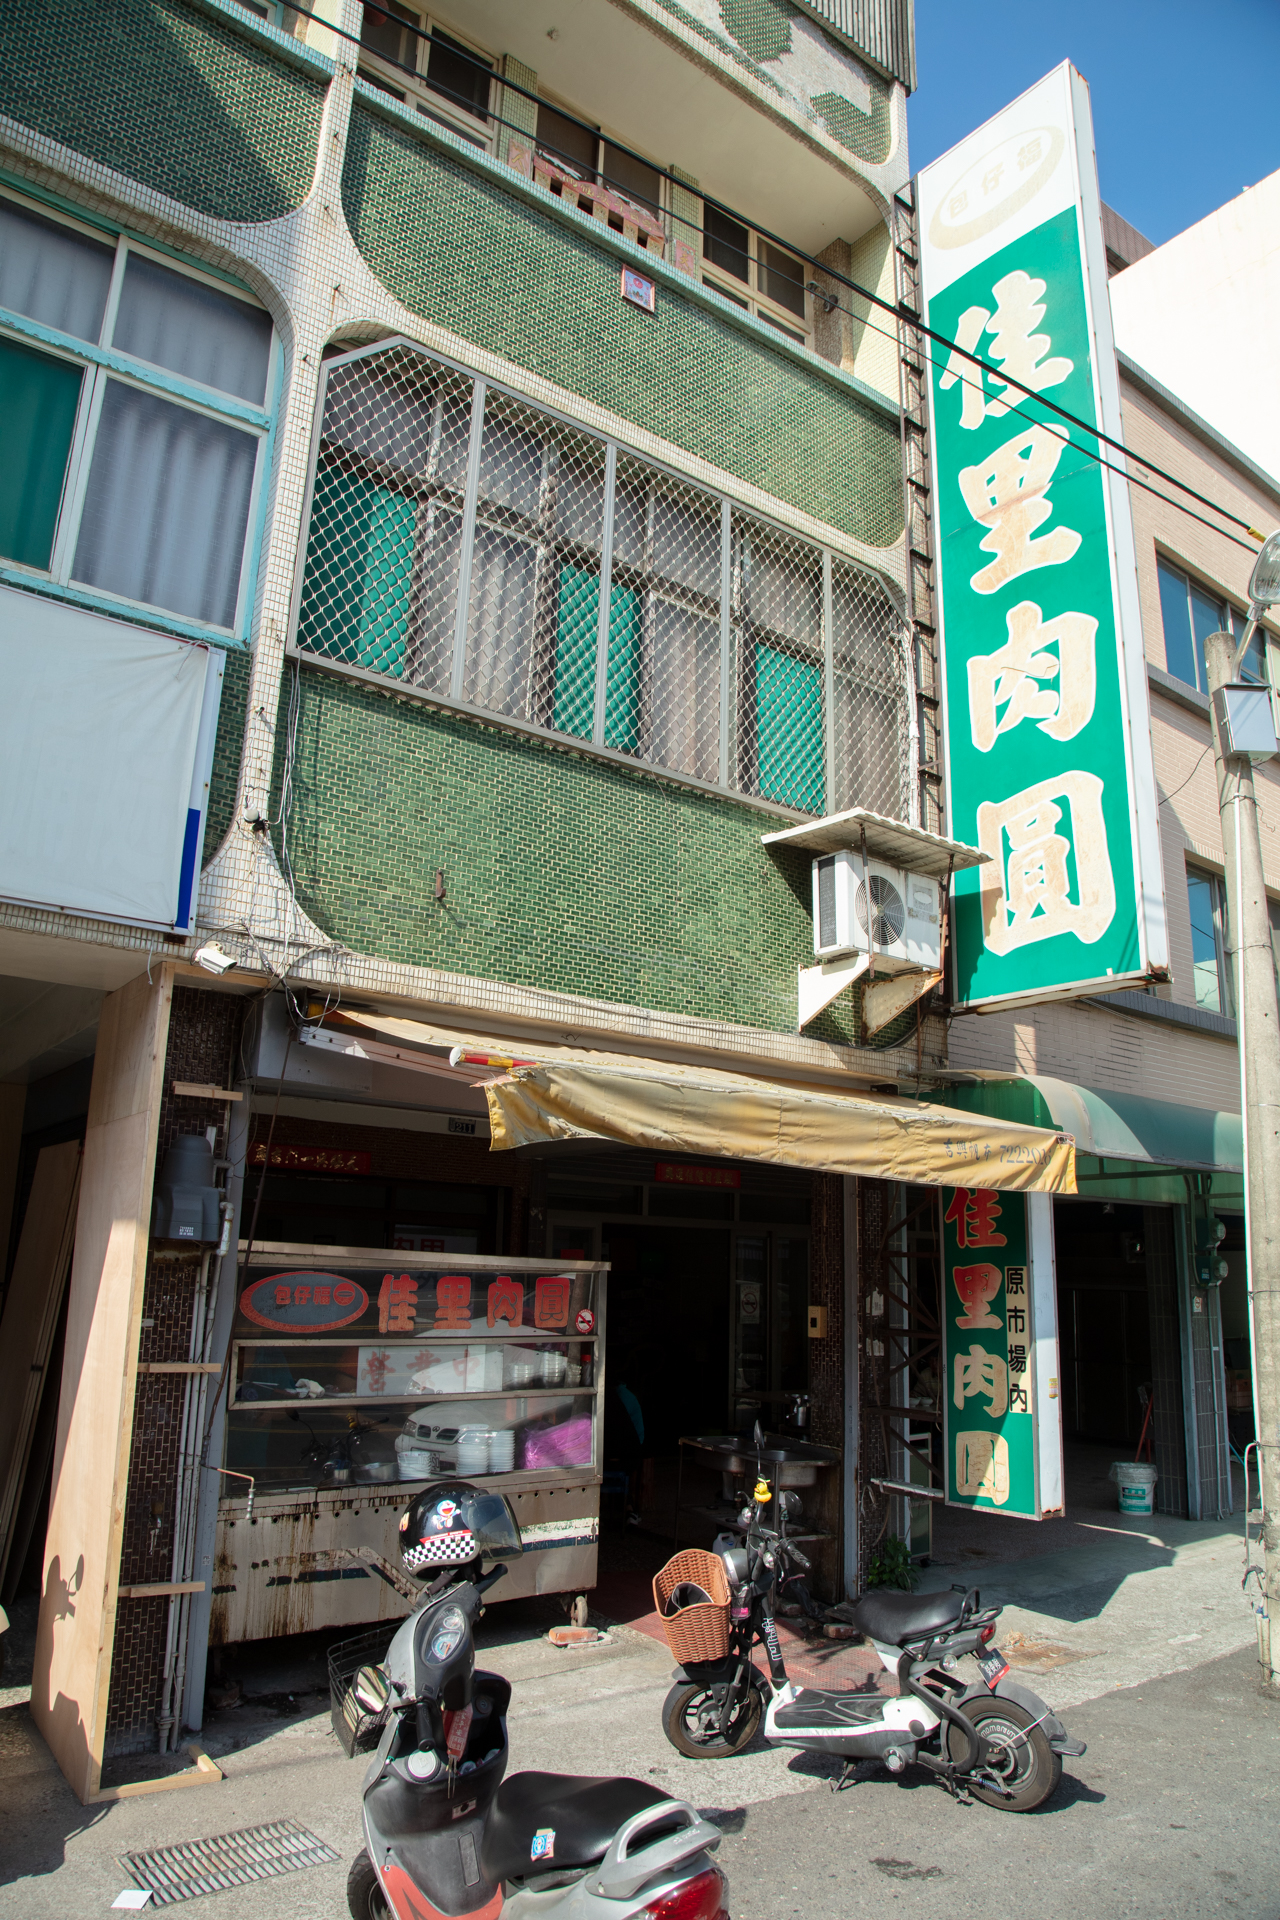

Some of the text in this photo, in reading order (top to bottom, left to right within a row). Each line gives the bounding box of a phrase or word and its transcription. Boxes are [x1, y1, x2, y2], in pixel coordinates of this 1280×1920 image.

[938, 269, 1117, 957] 佳里肉圓
[455, 1122, 472, 1134] 211
[377, 1274, 570, 1333] 佳里肉圓
[945, 1186, 1010, 1505] 佳里肉圓
